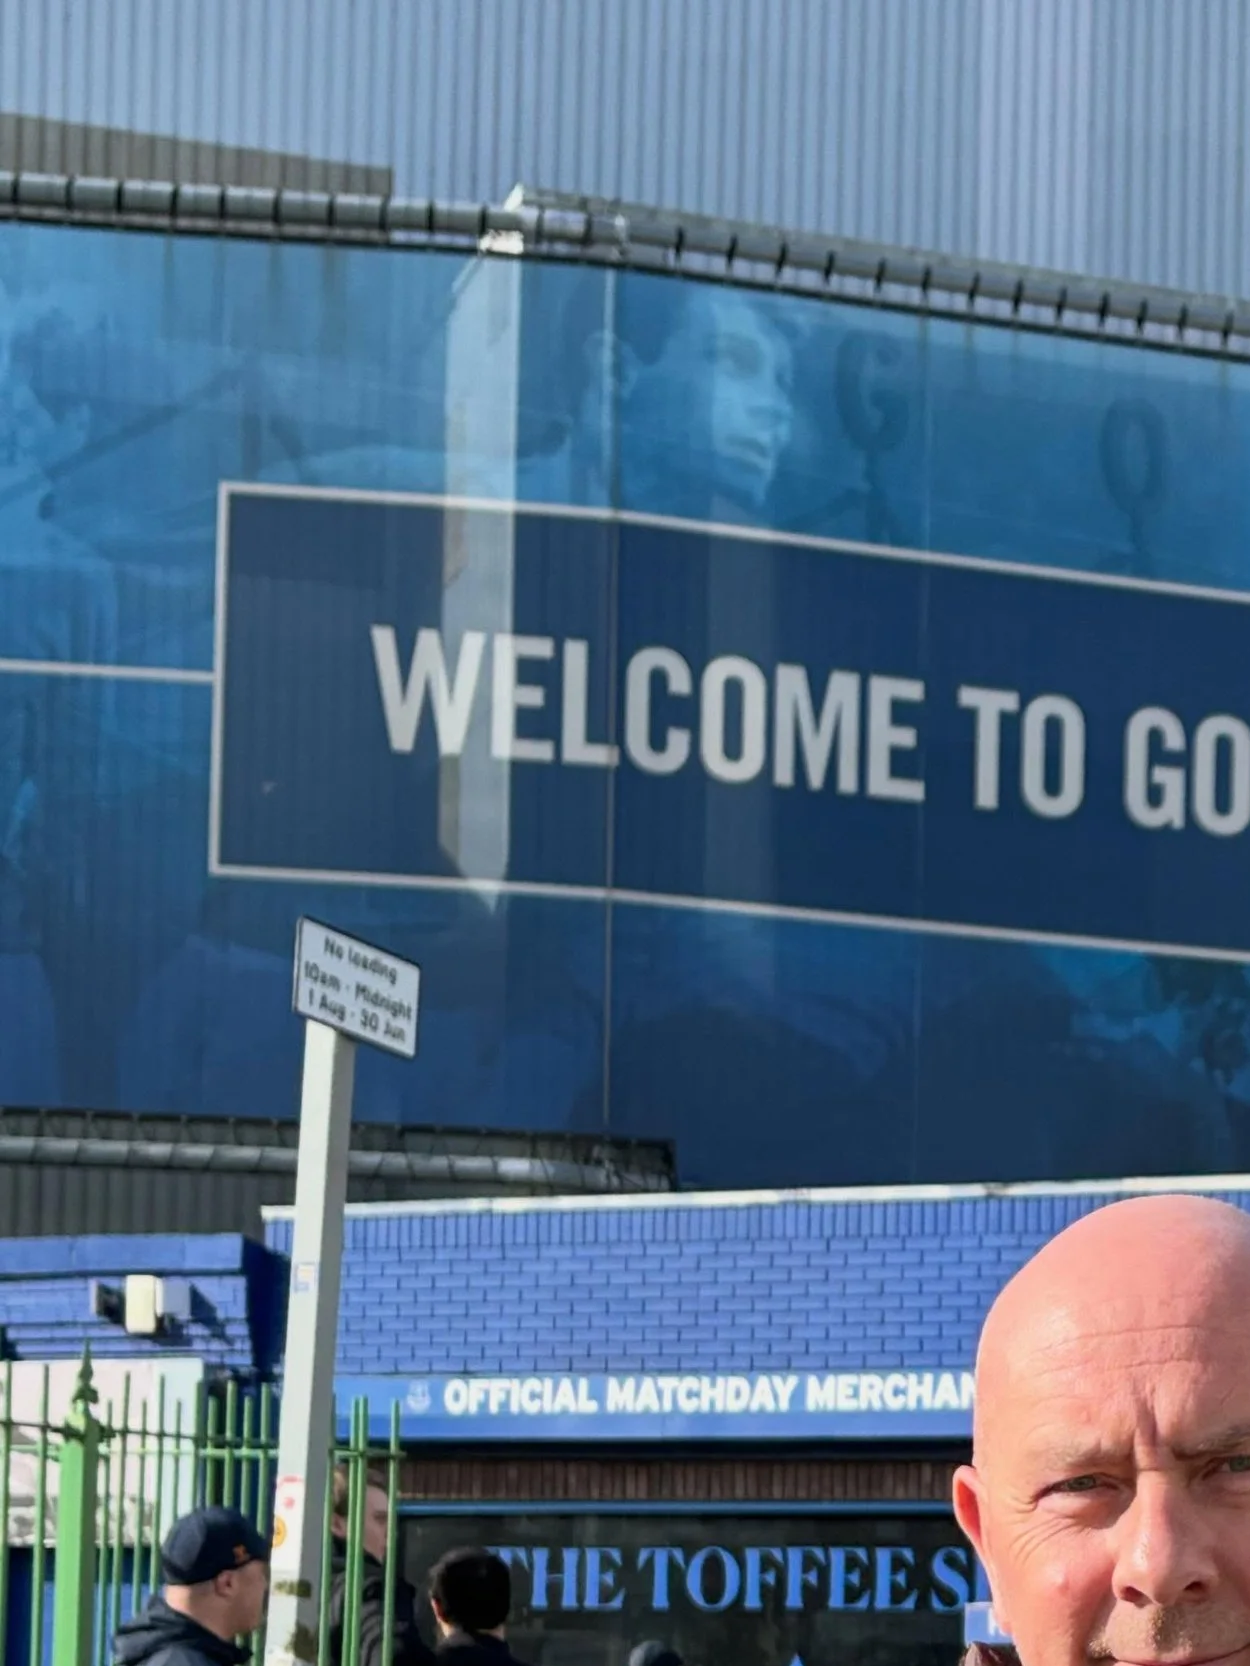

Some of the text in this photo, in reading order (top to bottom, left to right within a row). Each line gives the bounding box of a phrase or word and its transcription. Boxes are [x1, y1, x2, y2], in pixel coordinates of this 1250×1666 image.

[371, 624, 926, 802] WELCOME
[958, 685, 1085, 819] TO
[325, 937, 397, 984] No loading
[304, 961, 341, 992] 10am
[355, 982, 412, 1021] Midnight
[319, 994, 346, 1022] Aug
[444, 1377, 599, 1415] OFFICIAL
[606, 1375, 798, 1414] MATCHDAY
[637, 1546, 920, 1611] TOFFEE
